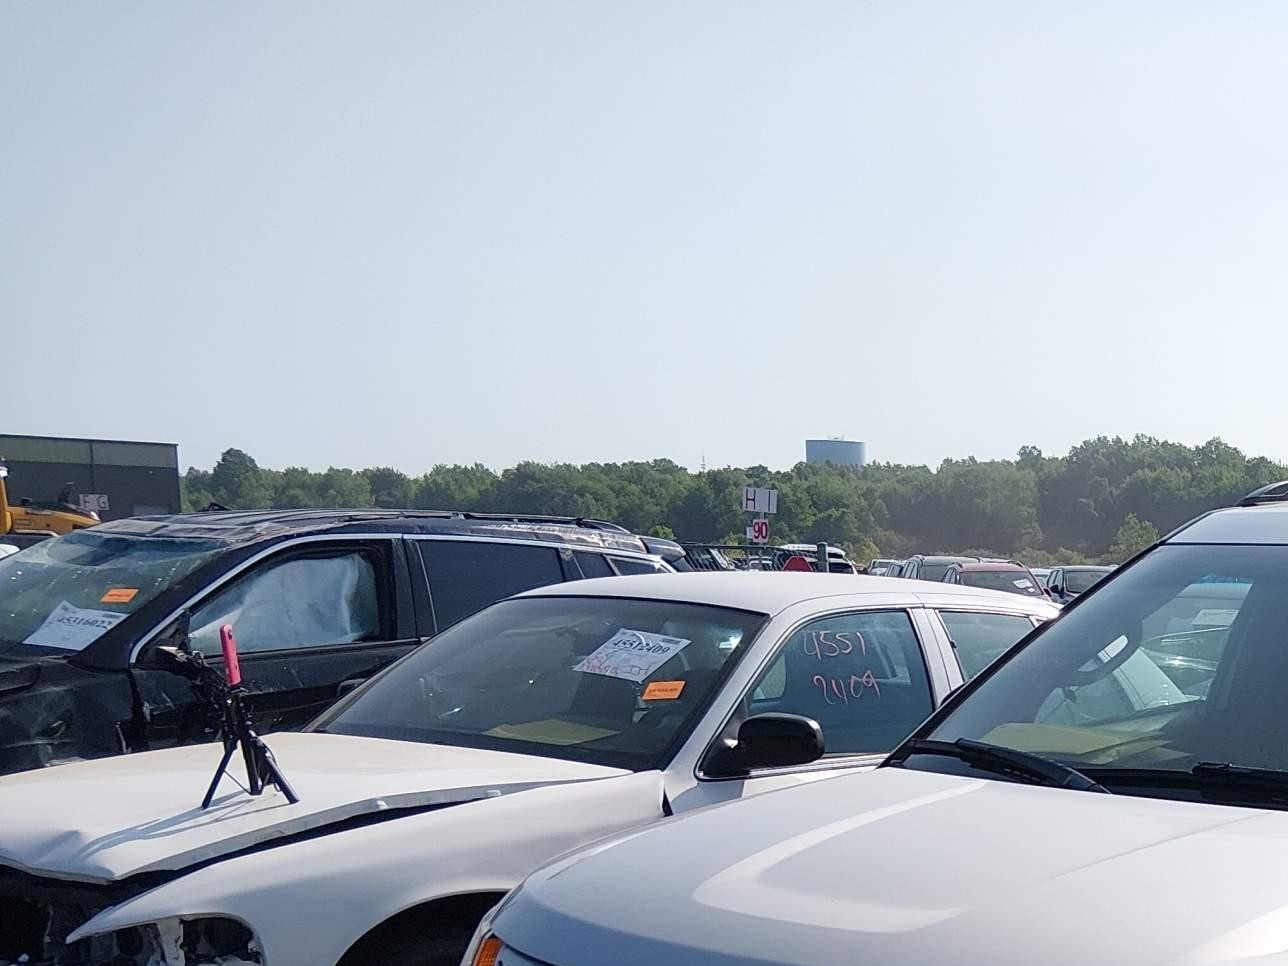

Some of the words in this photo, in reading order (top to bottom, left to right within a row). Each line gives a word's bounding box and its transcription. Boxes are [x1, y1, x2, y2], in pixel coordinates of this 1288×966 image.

[746, 489, 756, 510] H
[753, 522, 768, 540] 90
[613, 639, 671, 655] 45512409
[803, 630, 866, 660] 4551
